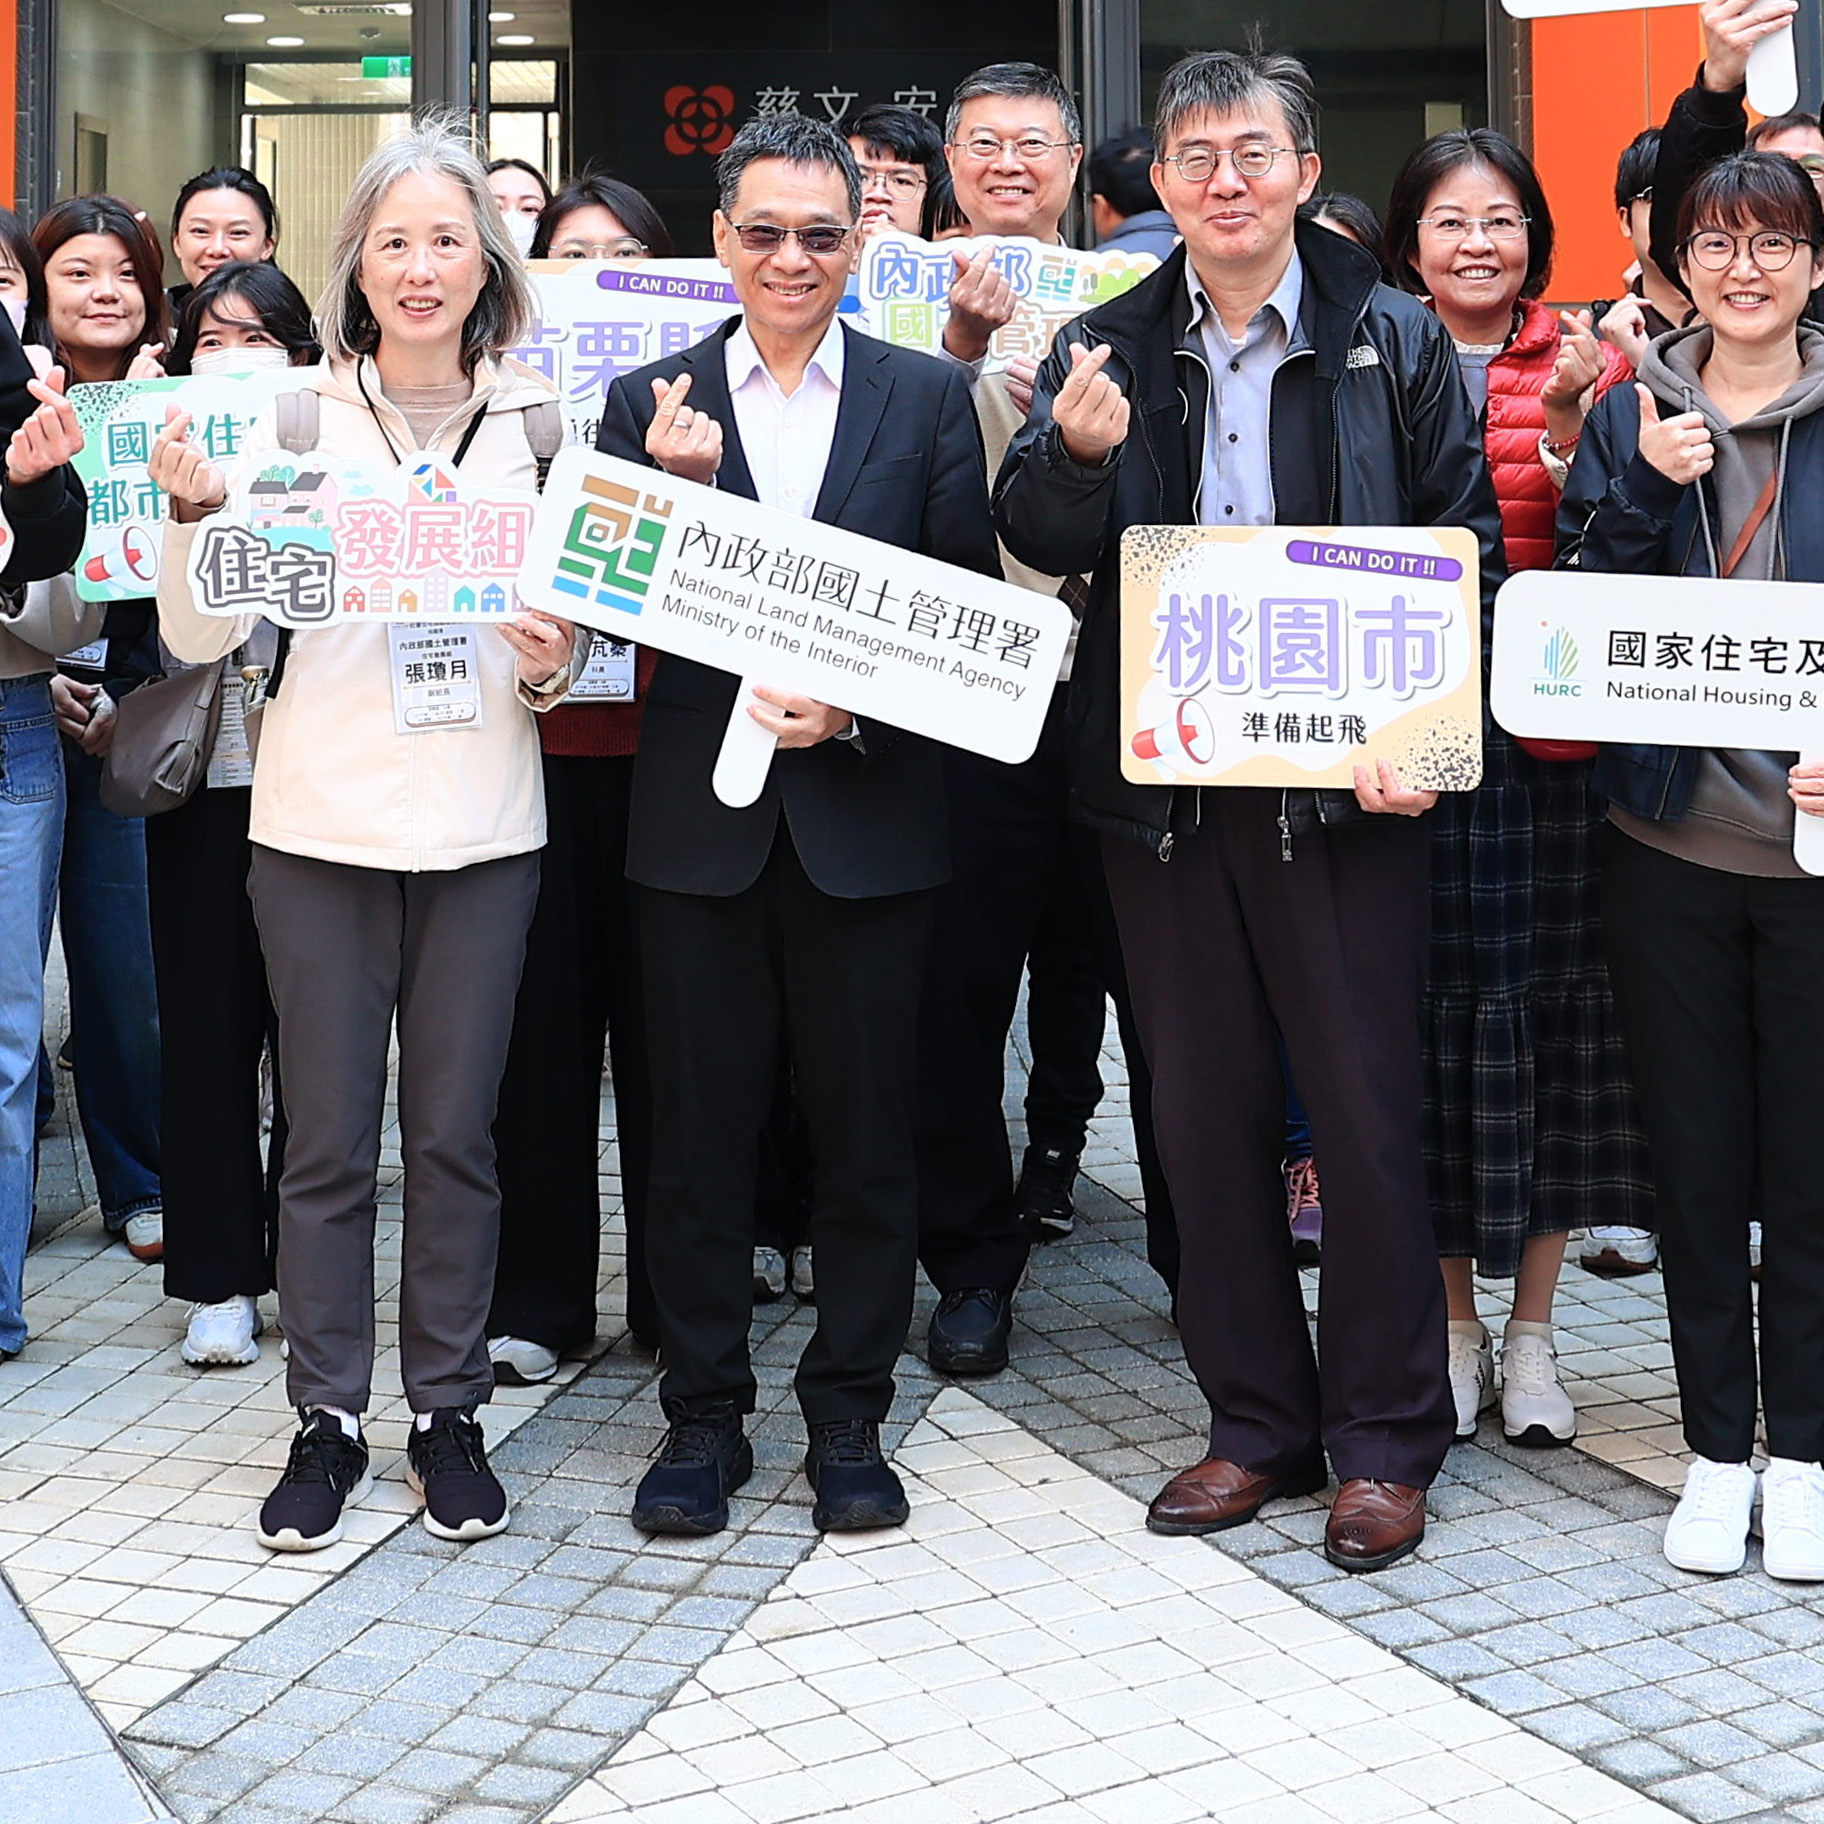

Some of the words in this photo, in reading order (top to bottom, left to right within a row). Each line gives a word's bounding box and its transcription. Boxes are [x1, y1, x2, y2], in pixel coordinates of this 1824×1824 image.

[619, 275, 625, 288] I
[629, 276, 661, 292] CAN
[666, 280, 689, 295] DO
[694, 283, 709, 297] IT
[713, 285, 724, 299] !!
[1313, 546, 1318, 561] I
[1324, 548, 1362, 567] CAN
[1367, 553, 1394, 570] DO
[1400, 556, 1417, 573] IT
[1423, 560, 1436, 575] !!
[678, 519, 1041, 670] 內政部國土管理署
[662, 594, 740, 639] Ministry
[744, 617, 768, 643] of
[770, 627, 802, 655] the
[807, 638, 880, 679] Interior
[671, 570, 751, 611] National
[756, 590, 808, 628] Land
[813, 607, 945, 672] Management
[950, 644, 1026, 702] Agency
[1156, 593, 1443, 692] 桃園市
[1534, 684, 1582, 697] HURC
[1606, 681, 1697, 703] National
[1703, 685, 1792, 712] Housing
[1799, 690, 1818, 708] &
[1242, 712, 1367, 745] 準備起飛
